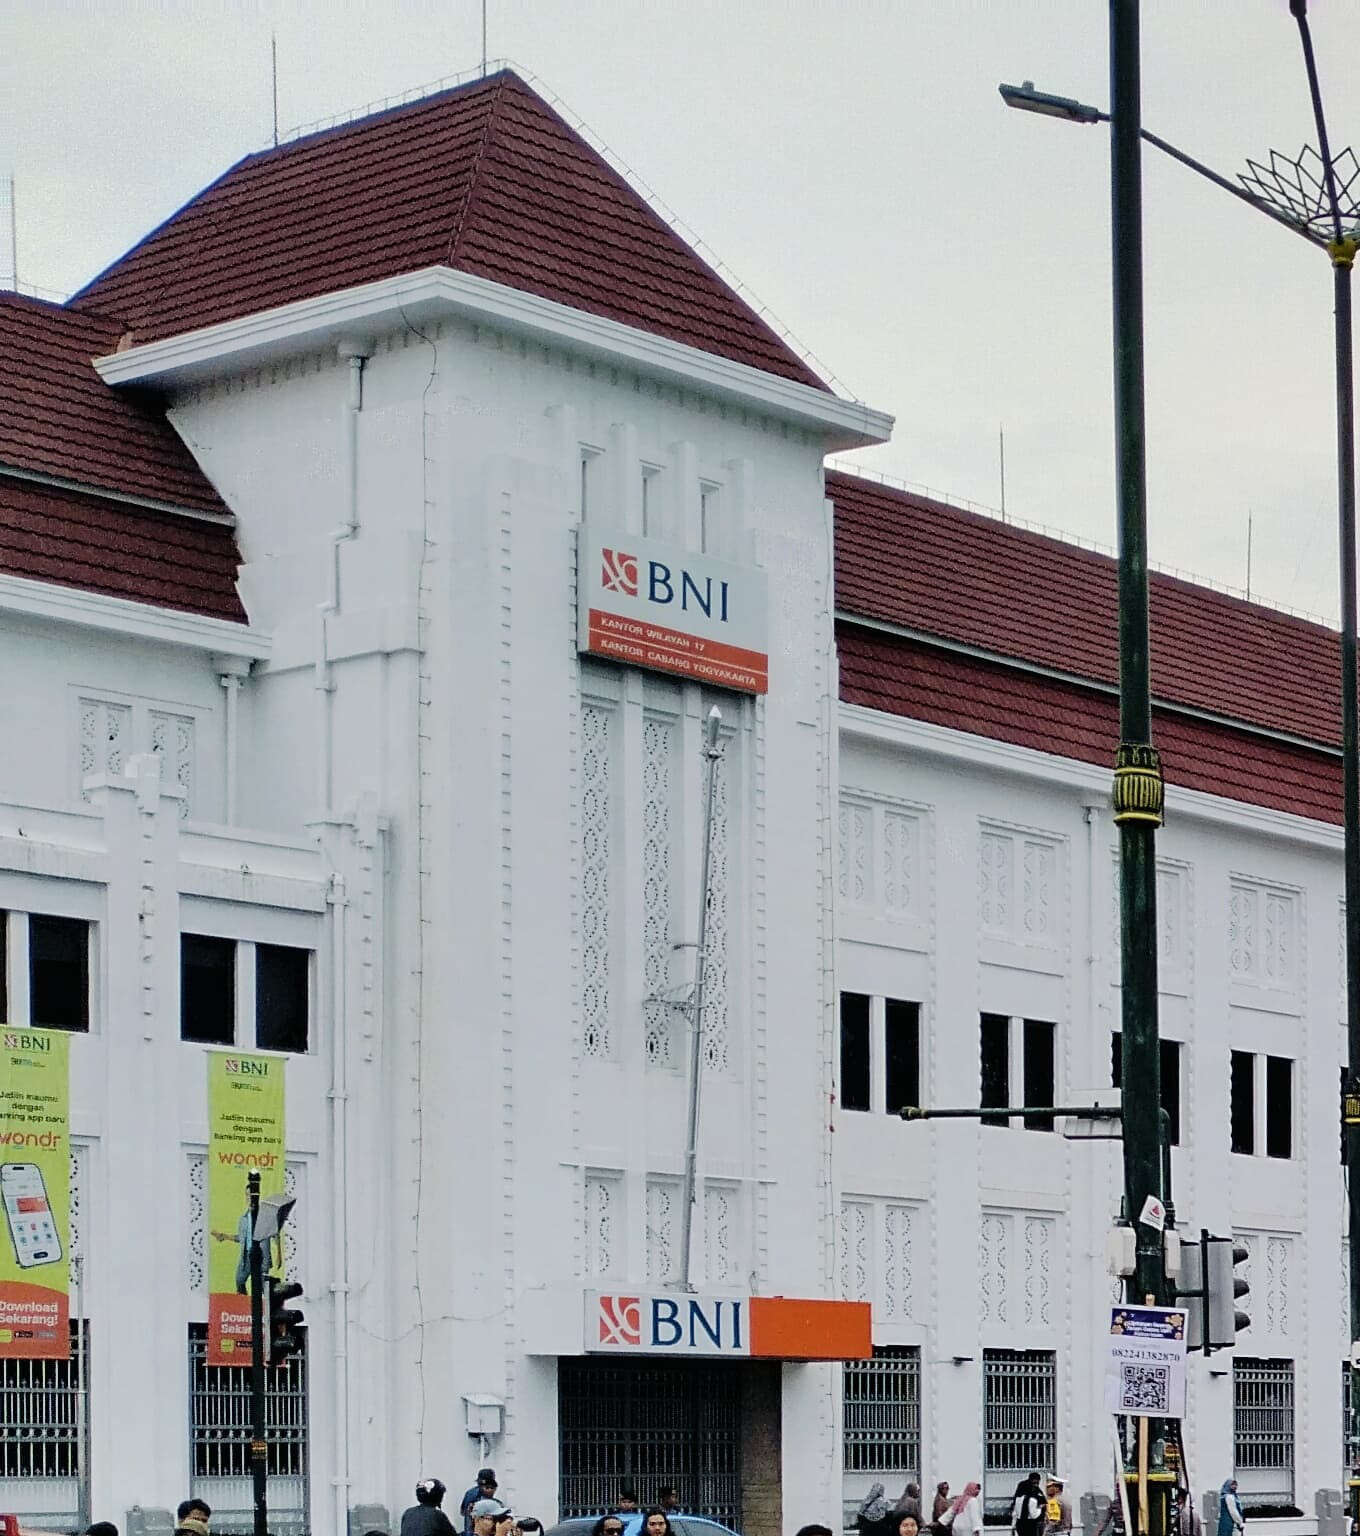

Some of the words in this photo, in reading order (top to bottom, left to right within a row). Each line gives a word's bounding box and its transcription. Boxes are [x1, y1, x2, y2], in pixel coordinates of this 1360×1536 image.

[648, 560, 729, 622] BNI
[600, 617, 643, 637] KANTOR
[647, 629, 690, 649] WILAYAH
[600, 638, 643, 657] KANTOR
[648, 652, 690, 670] CABANG
[694, 662, 756, 686] YOGYAKARTA
[21, 1035, 50, 1051] BNI
[240, 1061, 268, 1075] BNI
[0, 1132, 61, 1147] wondr
[218, 1152, 278, 1166] wondr
[0, 1301, 58, 1312] Download
[651, 1298, 741, 1349] BNI
